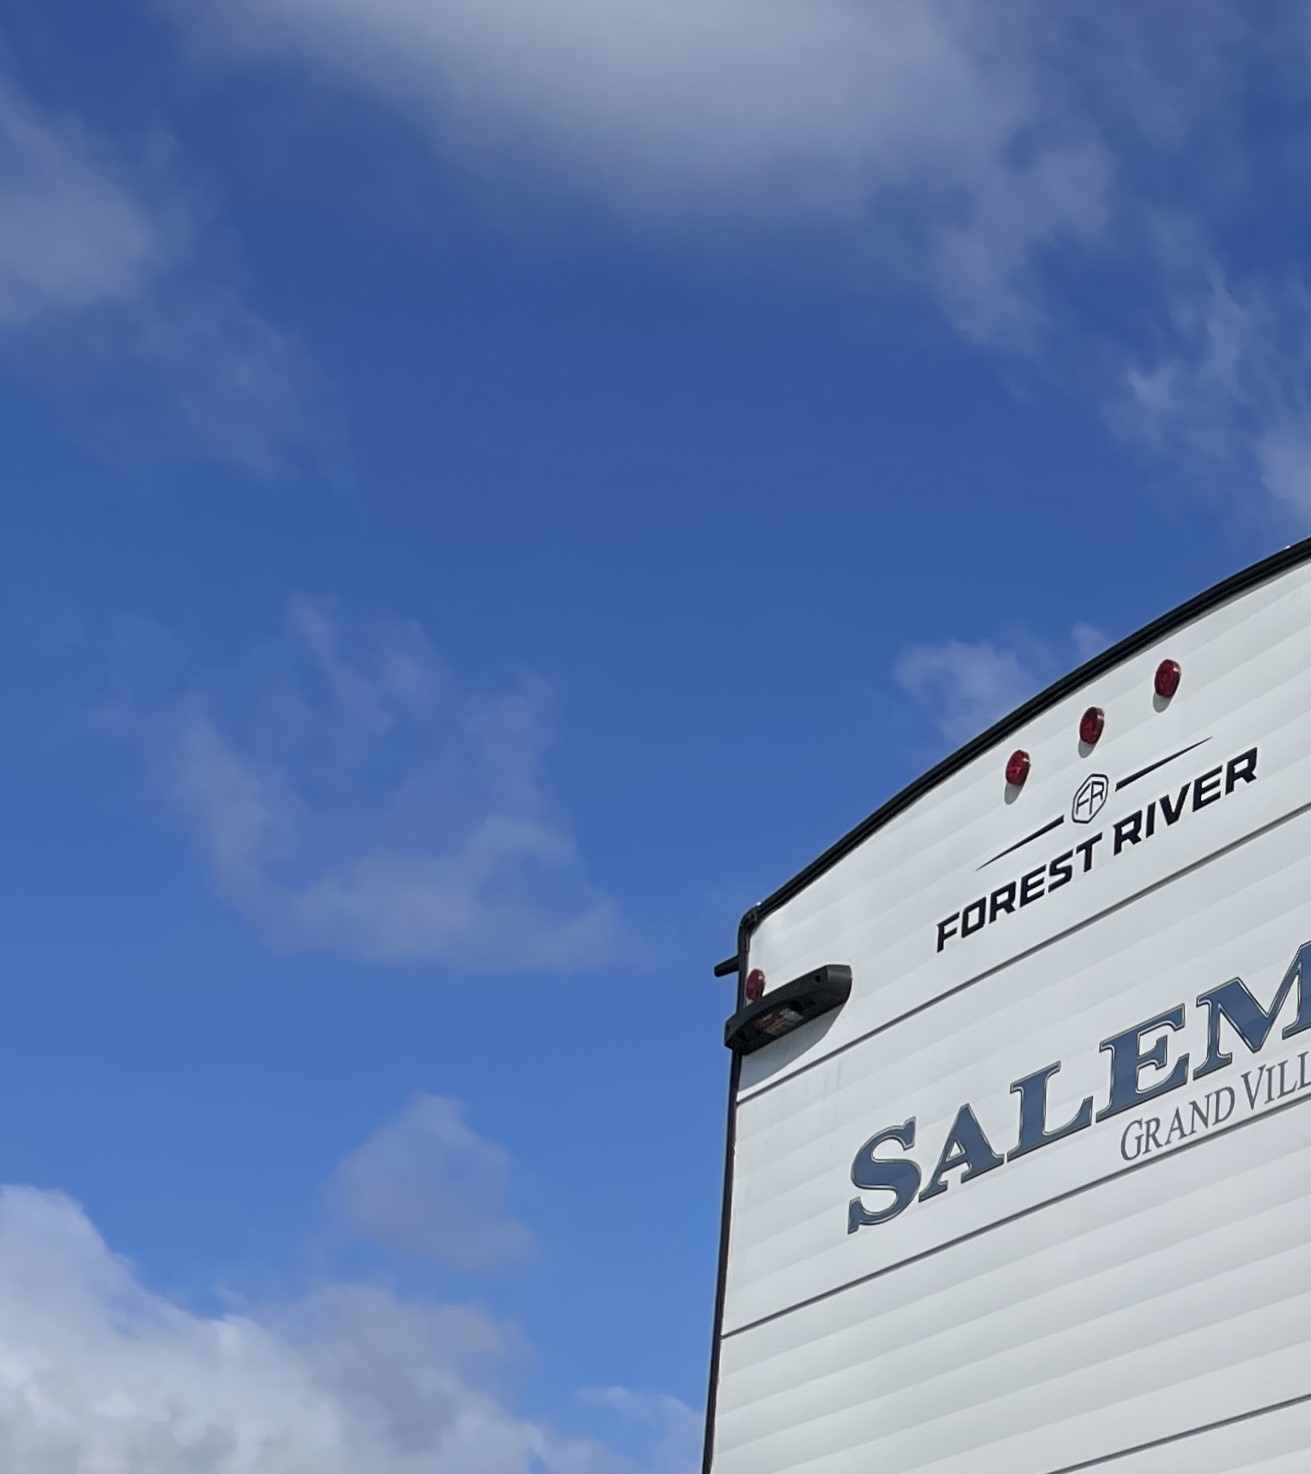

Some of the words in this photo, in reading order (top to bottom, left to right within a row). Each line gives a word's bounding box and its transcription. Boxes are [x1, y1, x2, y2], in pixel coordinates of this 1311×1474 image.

[936, 831, 1103, 953] FOREST
[1113, 747, 1258, 856] RIVER
[1119, 1086, 1236, 1162] GRAND
